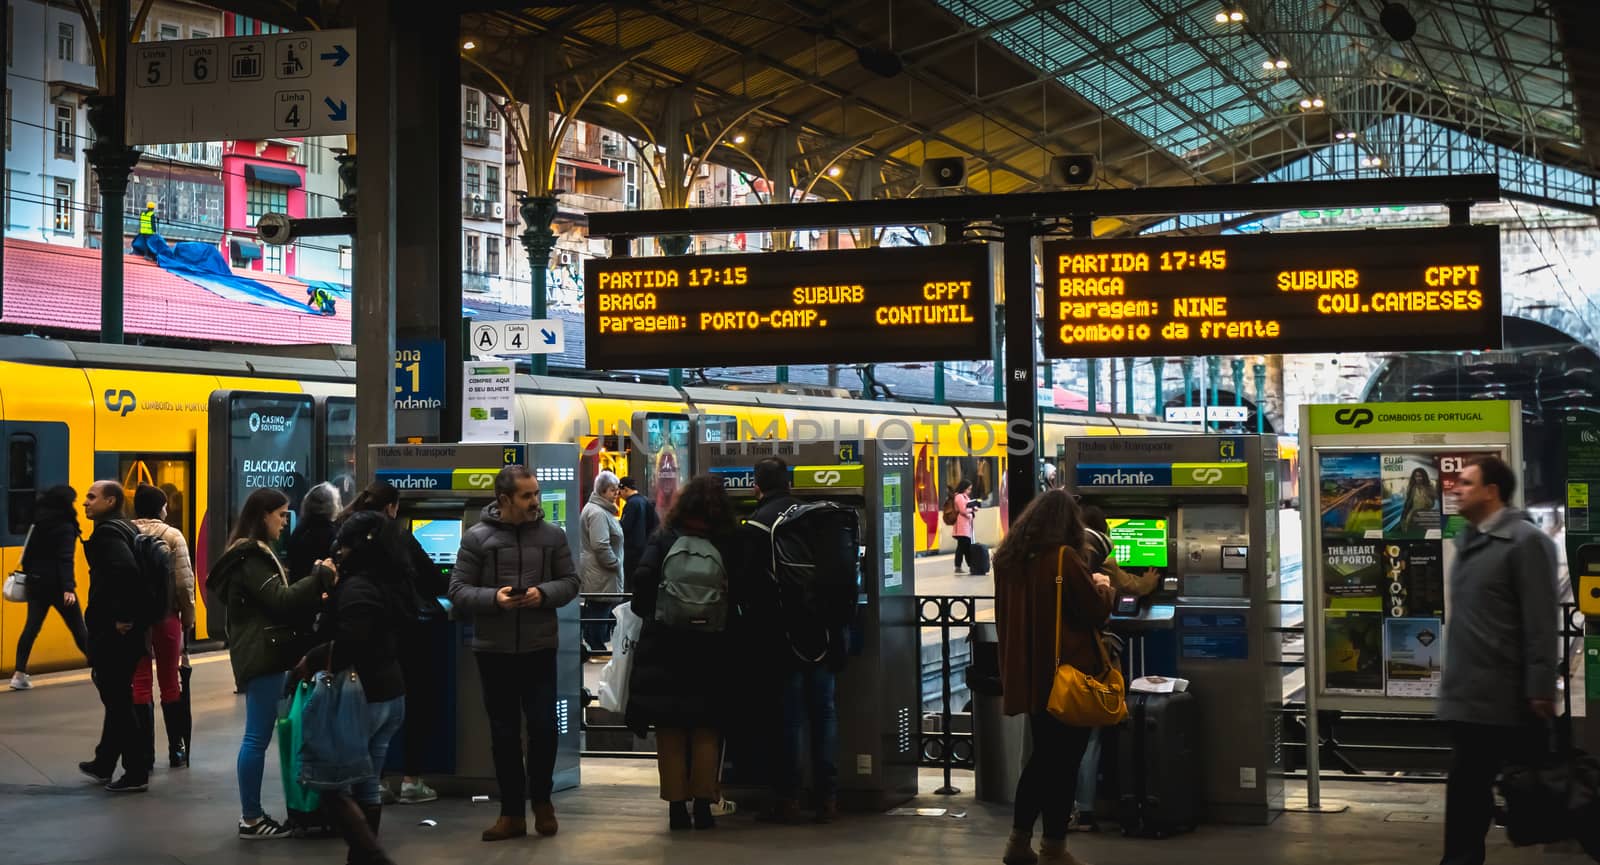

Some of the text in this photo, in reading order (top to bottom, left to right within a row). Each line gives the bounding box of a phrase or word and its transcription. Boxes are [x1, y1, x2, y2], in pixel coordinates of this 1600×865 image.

[142, 49, 166, 58] Linha
[189, 47, 212, 57] Linha
[147, 61, 161, 84] 5
[193, 57, 208, 81] 6
[281, 92, 305, 102] Linha
[284, 104, 300, 127] 4
[1059, 249, 1227, 274] PARTIDA 17:45
[599, 266, 748, 290] PARTIDA 17:15
[1059, 265, 1480, 297] BRAGA SUBURB CPPT
[599, 280, 972, 312] BRAGA SUBURB CPPT
[1059, 290, 1482, 320] Paragem: NINE COU.CAMBESES
[599, 304, 974, 333] Paragem: PORTO-CAMP. CONTUMIL
[1059, 318, 1280, 344] Comboio da frente
[479, 331, 493, 347] A
[511, 333, 522, 348] 4
[395, 349, 421, 362] ona
[496, 376, 510, 384] AQUI
[1014, 368, 1027, 379] EW
[394, 395, 441, 409] ndante
[261, 415, 285, 424] CASINO
[1377, 412, 1483, 422] COMBOIOS DE PORTUGAL
[504, 452, 516, 463] C1
[840, 448, 853, 460] C1
[1220, 445, 1235, 457] C1
[243, 460, 297, 473] BLACKJACK
[246, 475, 295, 488] EXCLUSIVO
[387, 474, 438, 488] andante
[723, 474, 755, 488] anda
[1092, 469, 1154, 484] andante
[1328, 545, 1376, 556] THE HEART
[1328, 555, 1377, 565] OF PORTO.
[1388, 545, 1402, 618] OUTONO
